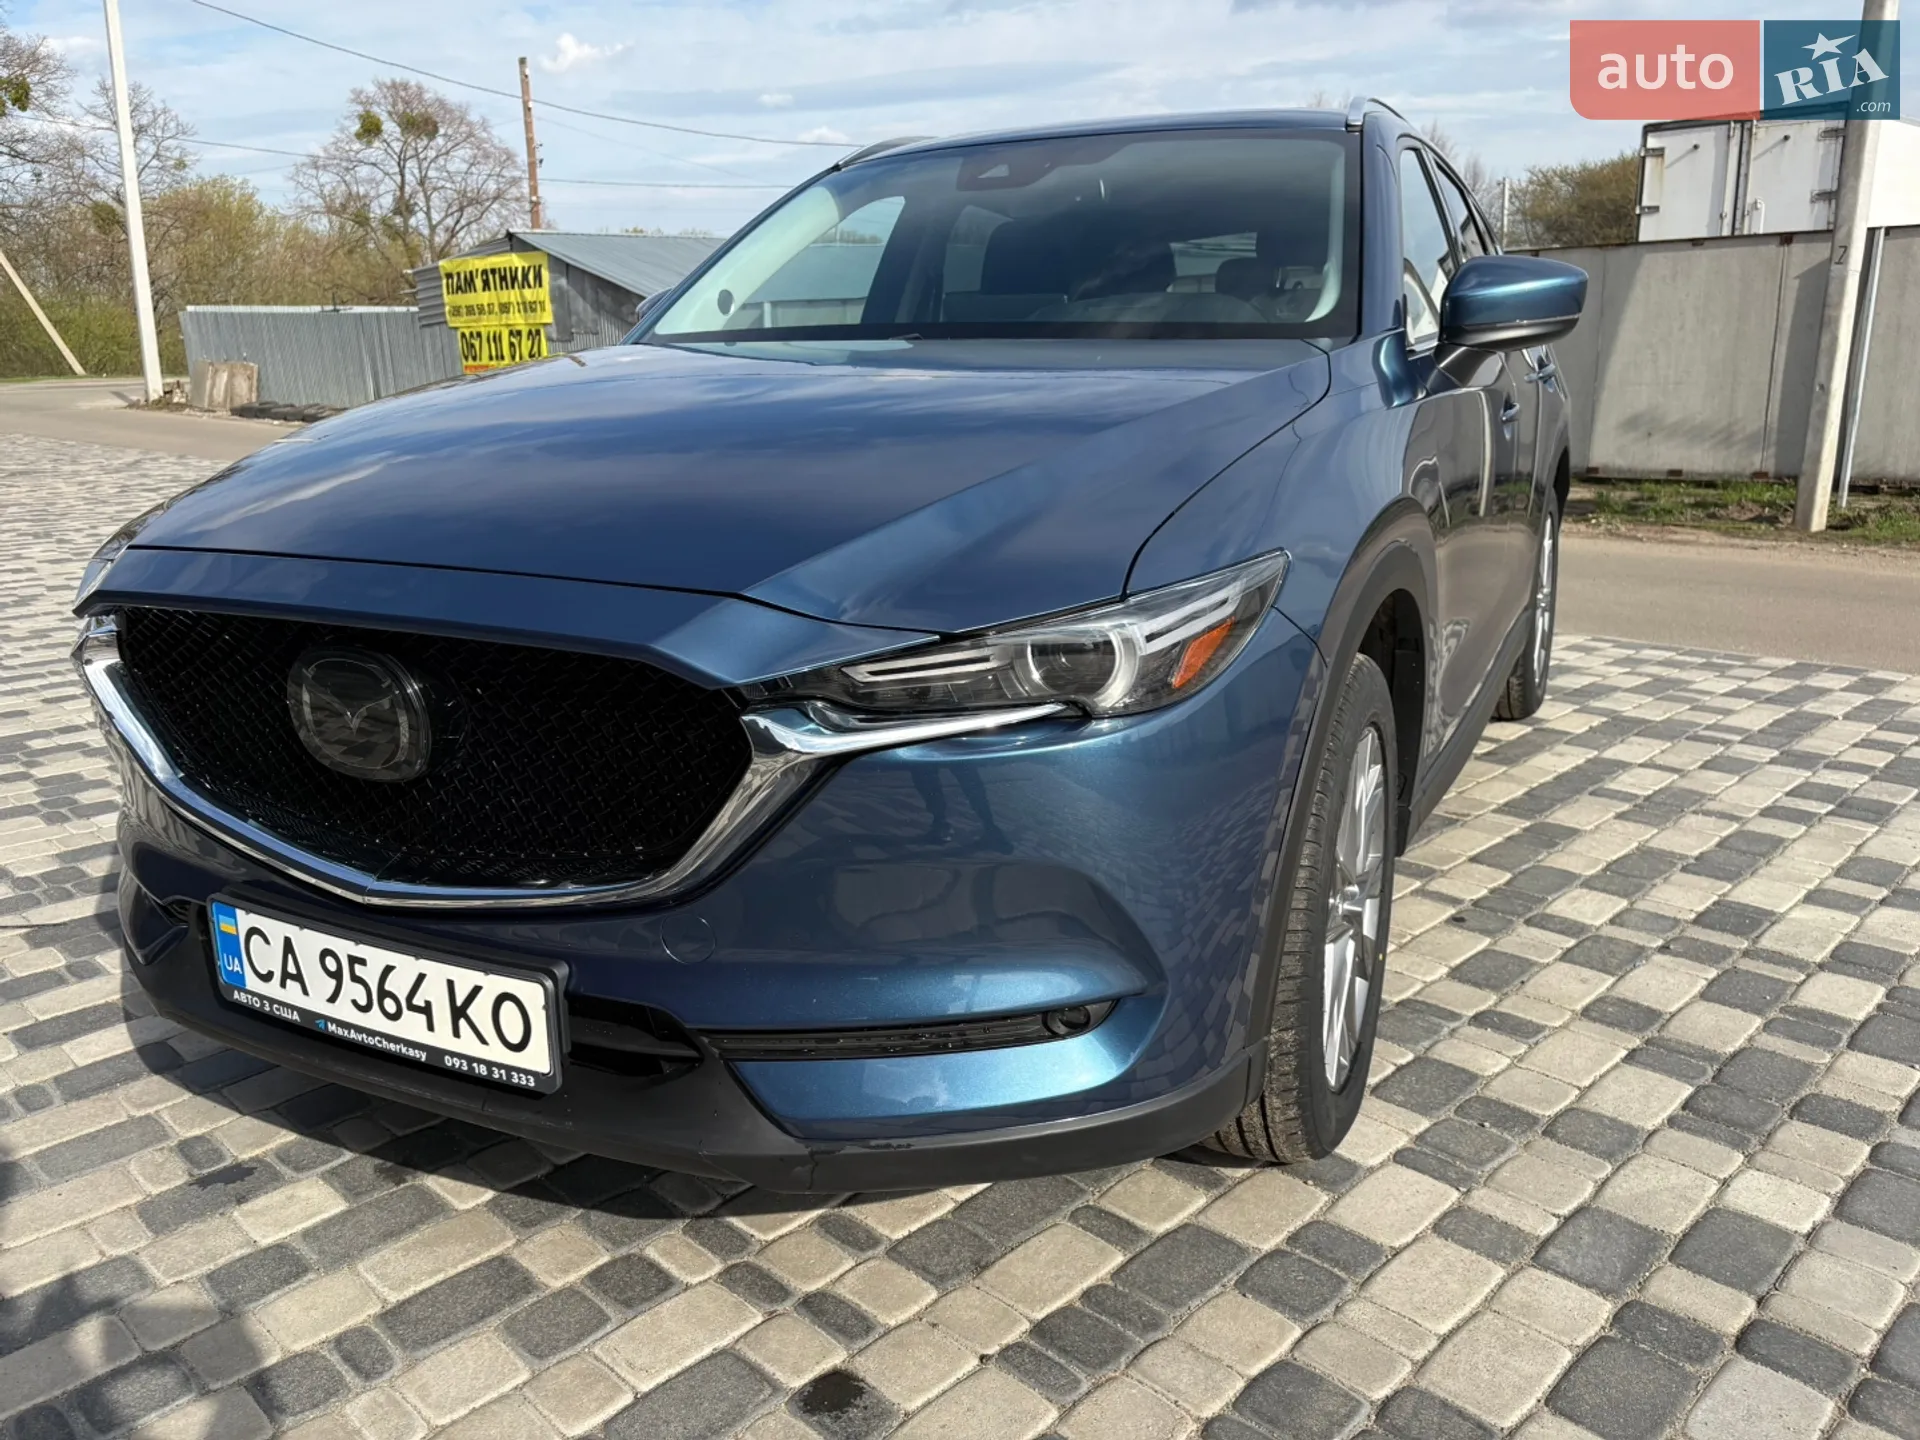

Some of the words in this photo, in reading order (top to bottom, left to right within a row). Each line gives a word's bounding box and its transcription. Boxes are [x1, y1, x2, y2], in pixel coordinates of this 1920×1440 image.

[444, 264, 543, 295] ПАМ'ЯТНИКИ
[460, 330, 483, 363] 067
[486, 329, 505, 362] 111
[508, 328, 523, 362] 67
[526, 327, 542, 360] 27
[223, 953, 243, 975] UA
[233, 989, 261, 1008] АВТО
[272, 1003, 301, 1022] США
[243, 926, 310, 997] CA
[318, 948, 435, 1033] 9564
[445, 978, 532, 1053] KO
[326, 1020, 427, 1062] MaxAvtoCherkasy
[443, 1054, 468, 1071] 093
[471, 1062, 488, 1076] 18
[491, 1067, 507, 1081] 31
[510, 1071, 536, 1088] 333
